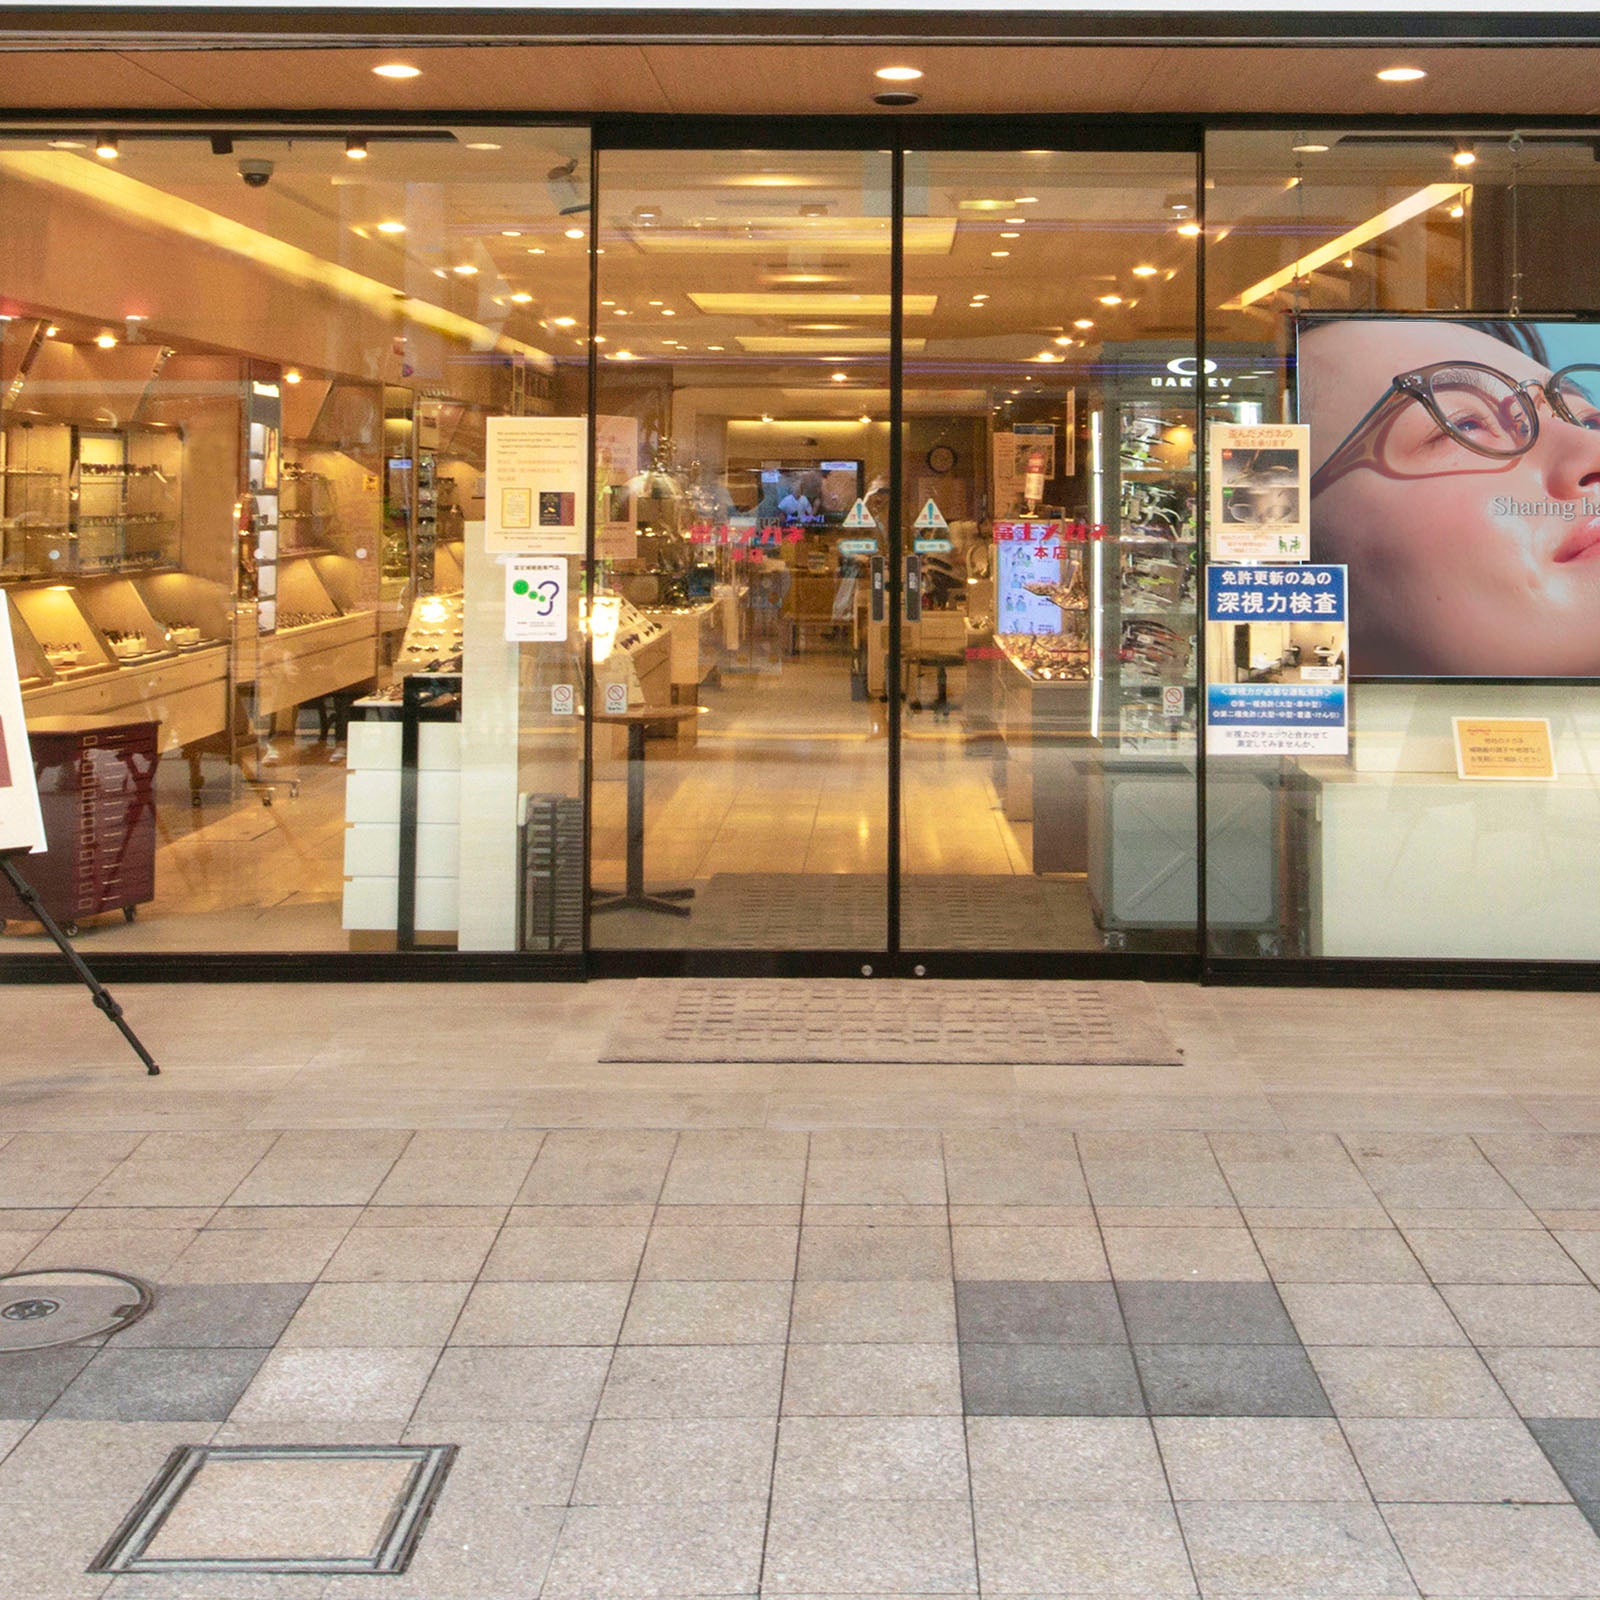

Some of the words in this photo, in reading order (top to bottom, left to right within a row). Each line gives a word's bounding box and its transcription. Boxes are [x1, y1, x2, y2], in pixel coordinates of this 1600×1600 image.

[1151, 377, 1233, 388] OAKEY
[1493, 497, 1576, 520] Sharing
[1222, 571, 1332, 586] 免許更新の為の
[1217, 592, 1337, 614] 深視力検査
